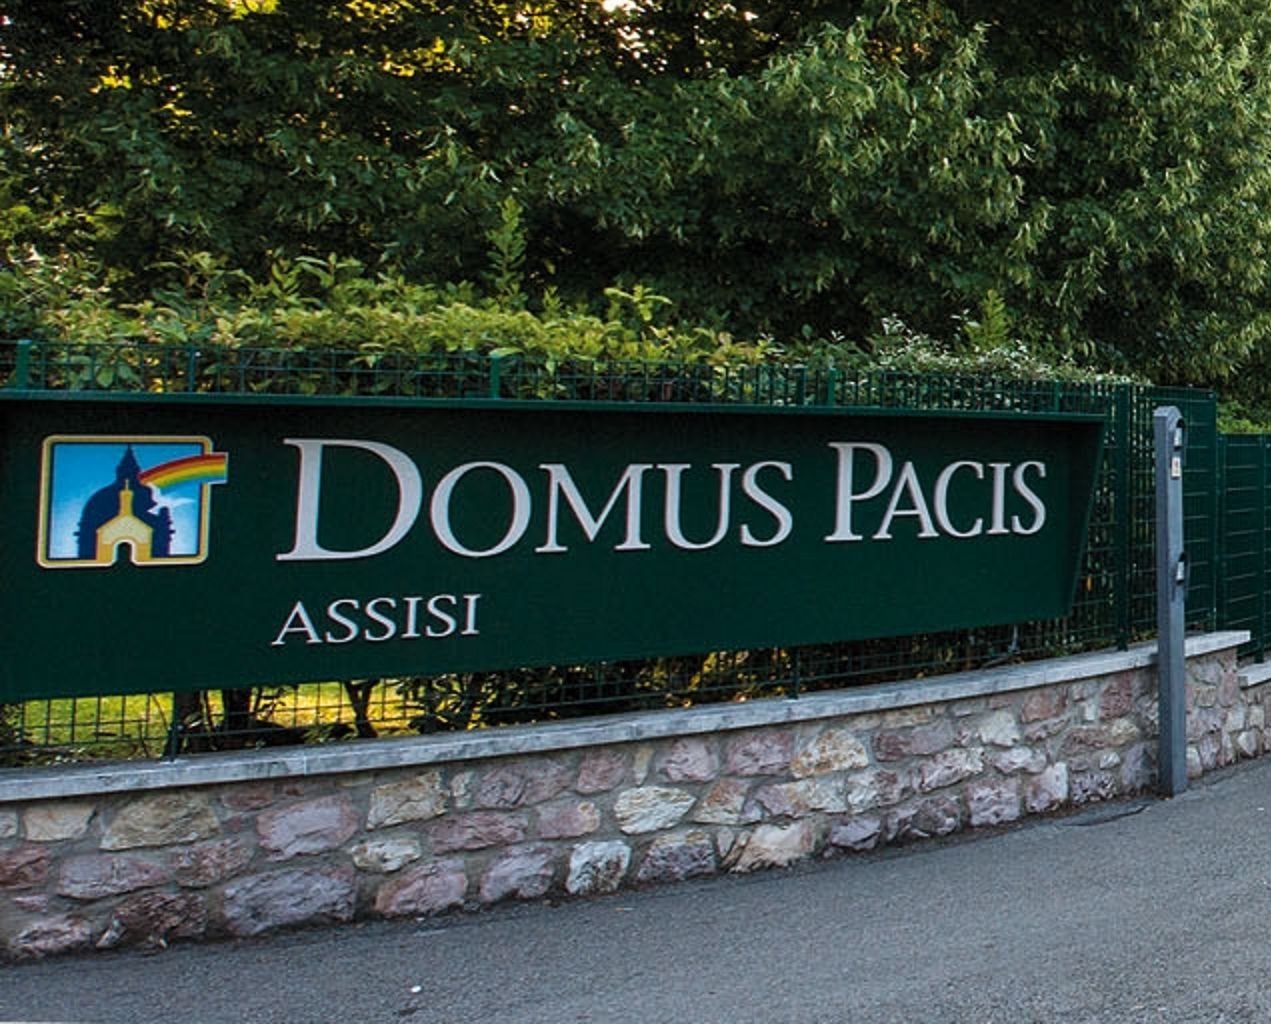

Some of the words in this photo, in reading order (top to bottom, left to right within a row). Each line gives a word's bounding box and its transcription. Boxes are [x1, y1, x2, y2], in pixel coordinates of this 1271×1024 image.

[275, 438, 793, 561] DOMUS
[824, 442, 1047, 542] PACIS
[271, 592, 482, 646] ASSISI
